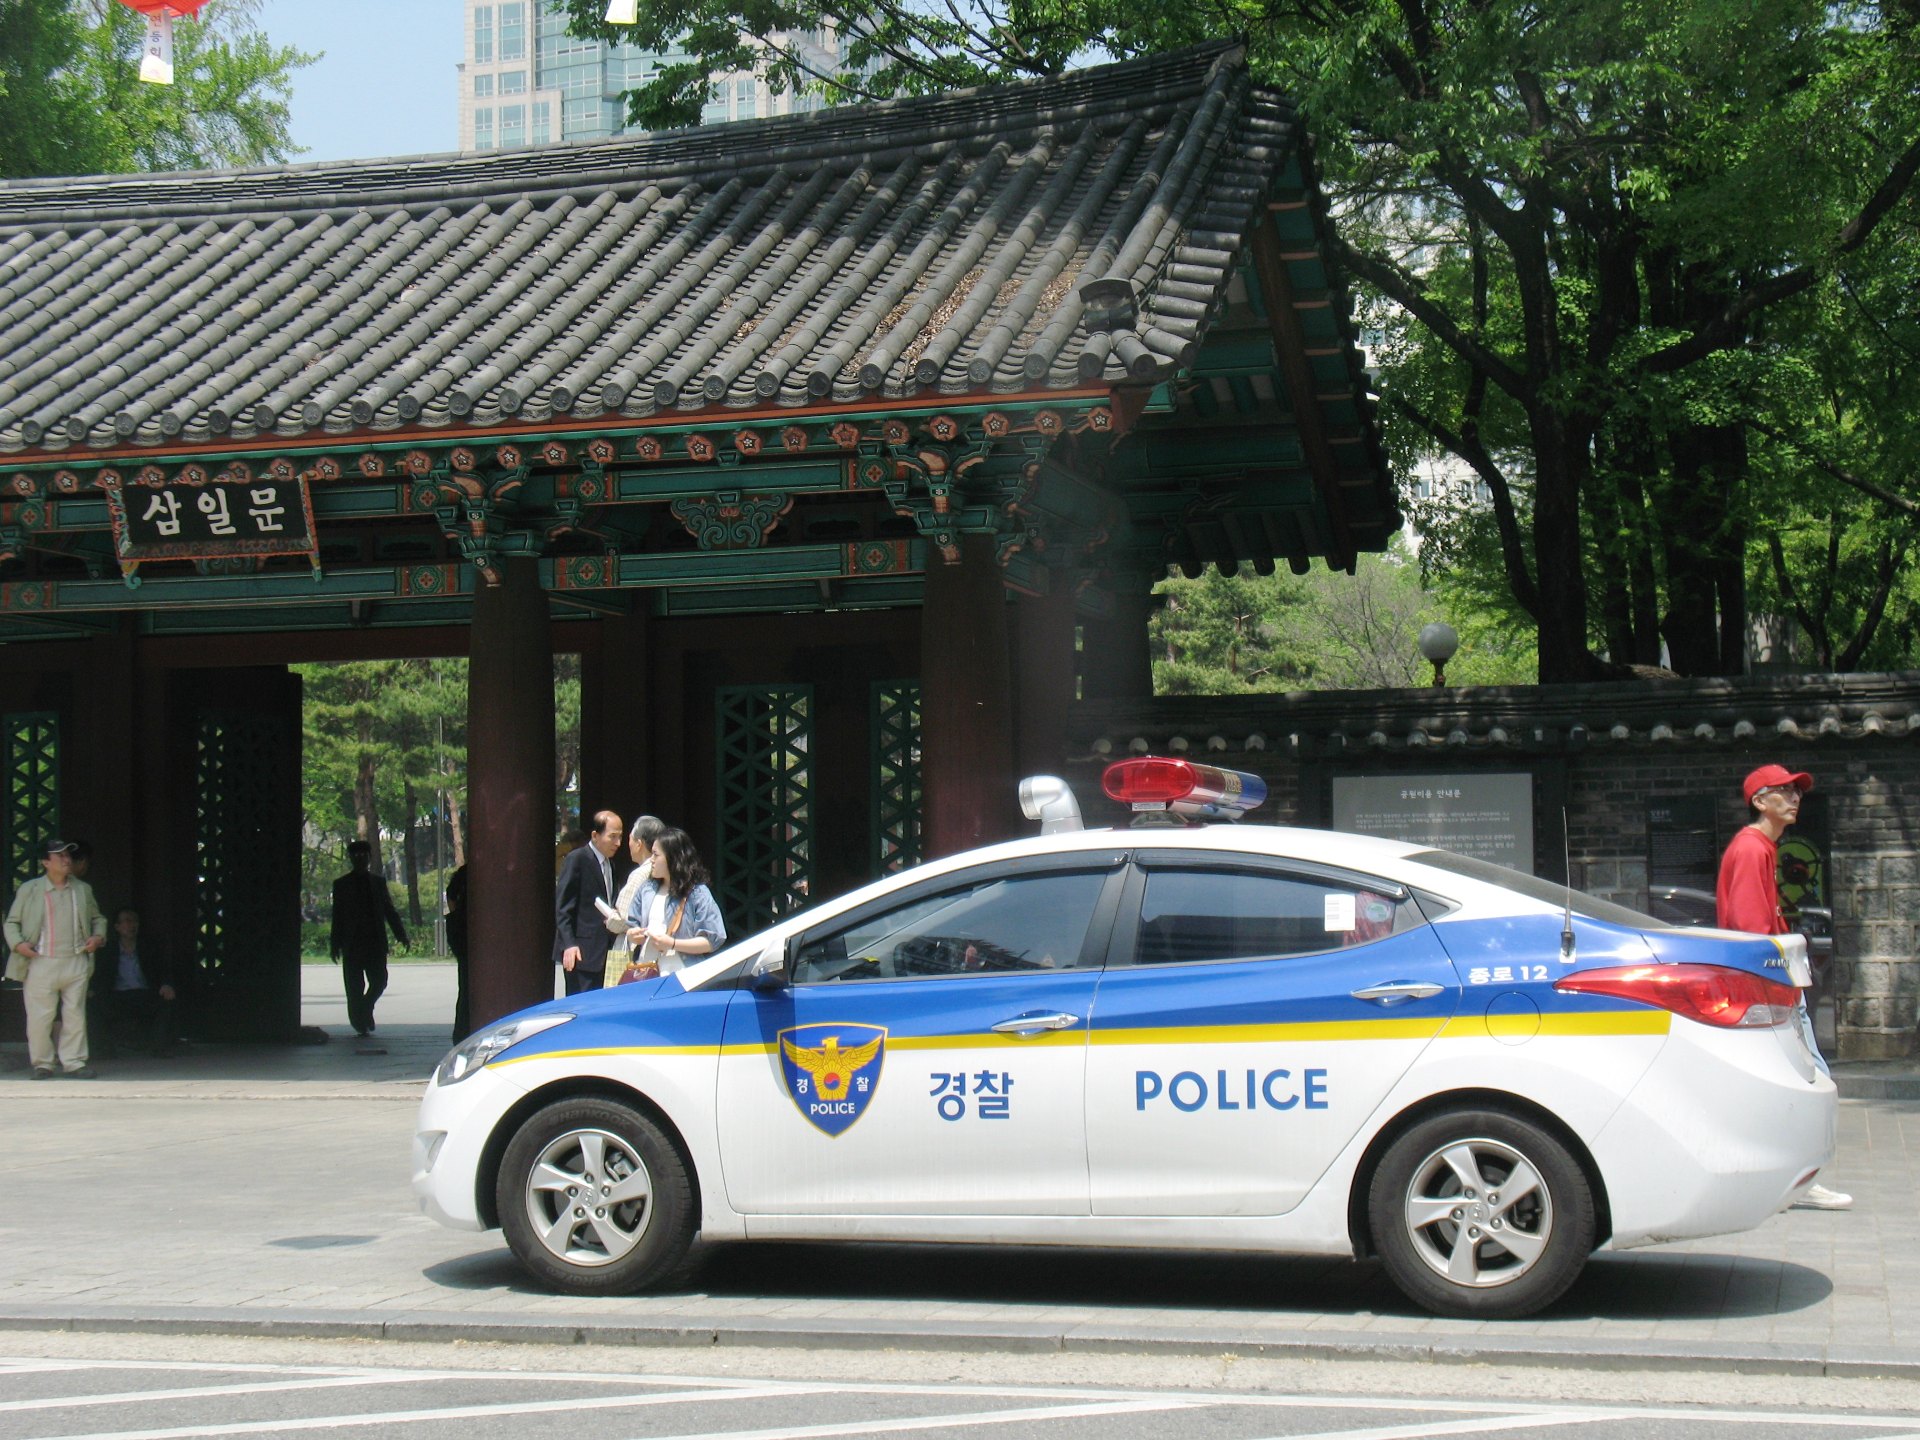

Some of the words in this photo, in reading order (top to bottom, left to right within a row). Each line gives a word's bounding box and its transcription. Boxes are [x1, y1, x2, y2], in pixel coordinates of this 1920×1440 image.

[142, 487, 285, 536] 삼일문
[1401, 789, 1433, 799] 공원이용
[1436, 788, 1462, 799] 안내문
[1468, 966, 1514, 984] 종로
[1520, 965, 1548, 980] 12
[796, 1078, 809, 1094] 경
[856, 1076, 870, 1092] 찰
[1135, 1068, 1329, 1112] POLICE
[929, 1070, 1015, 1122] 경찰
[810, 1102, 856, 1115] POLICE
